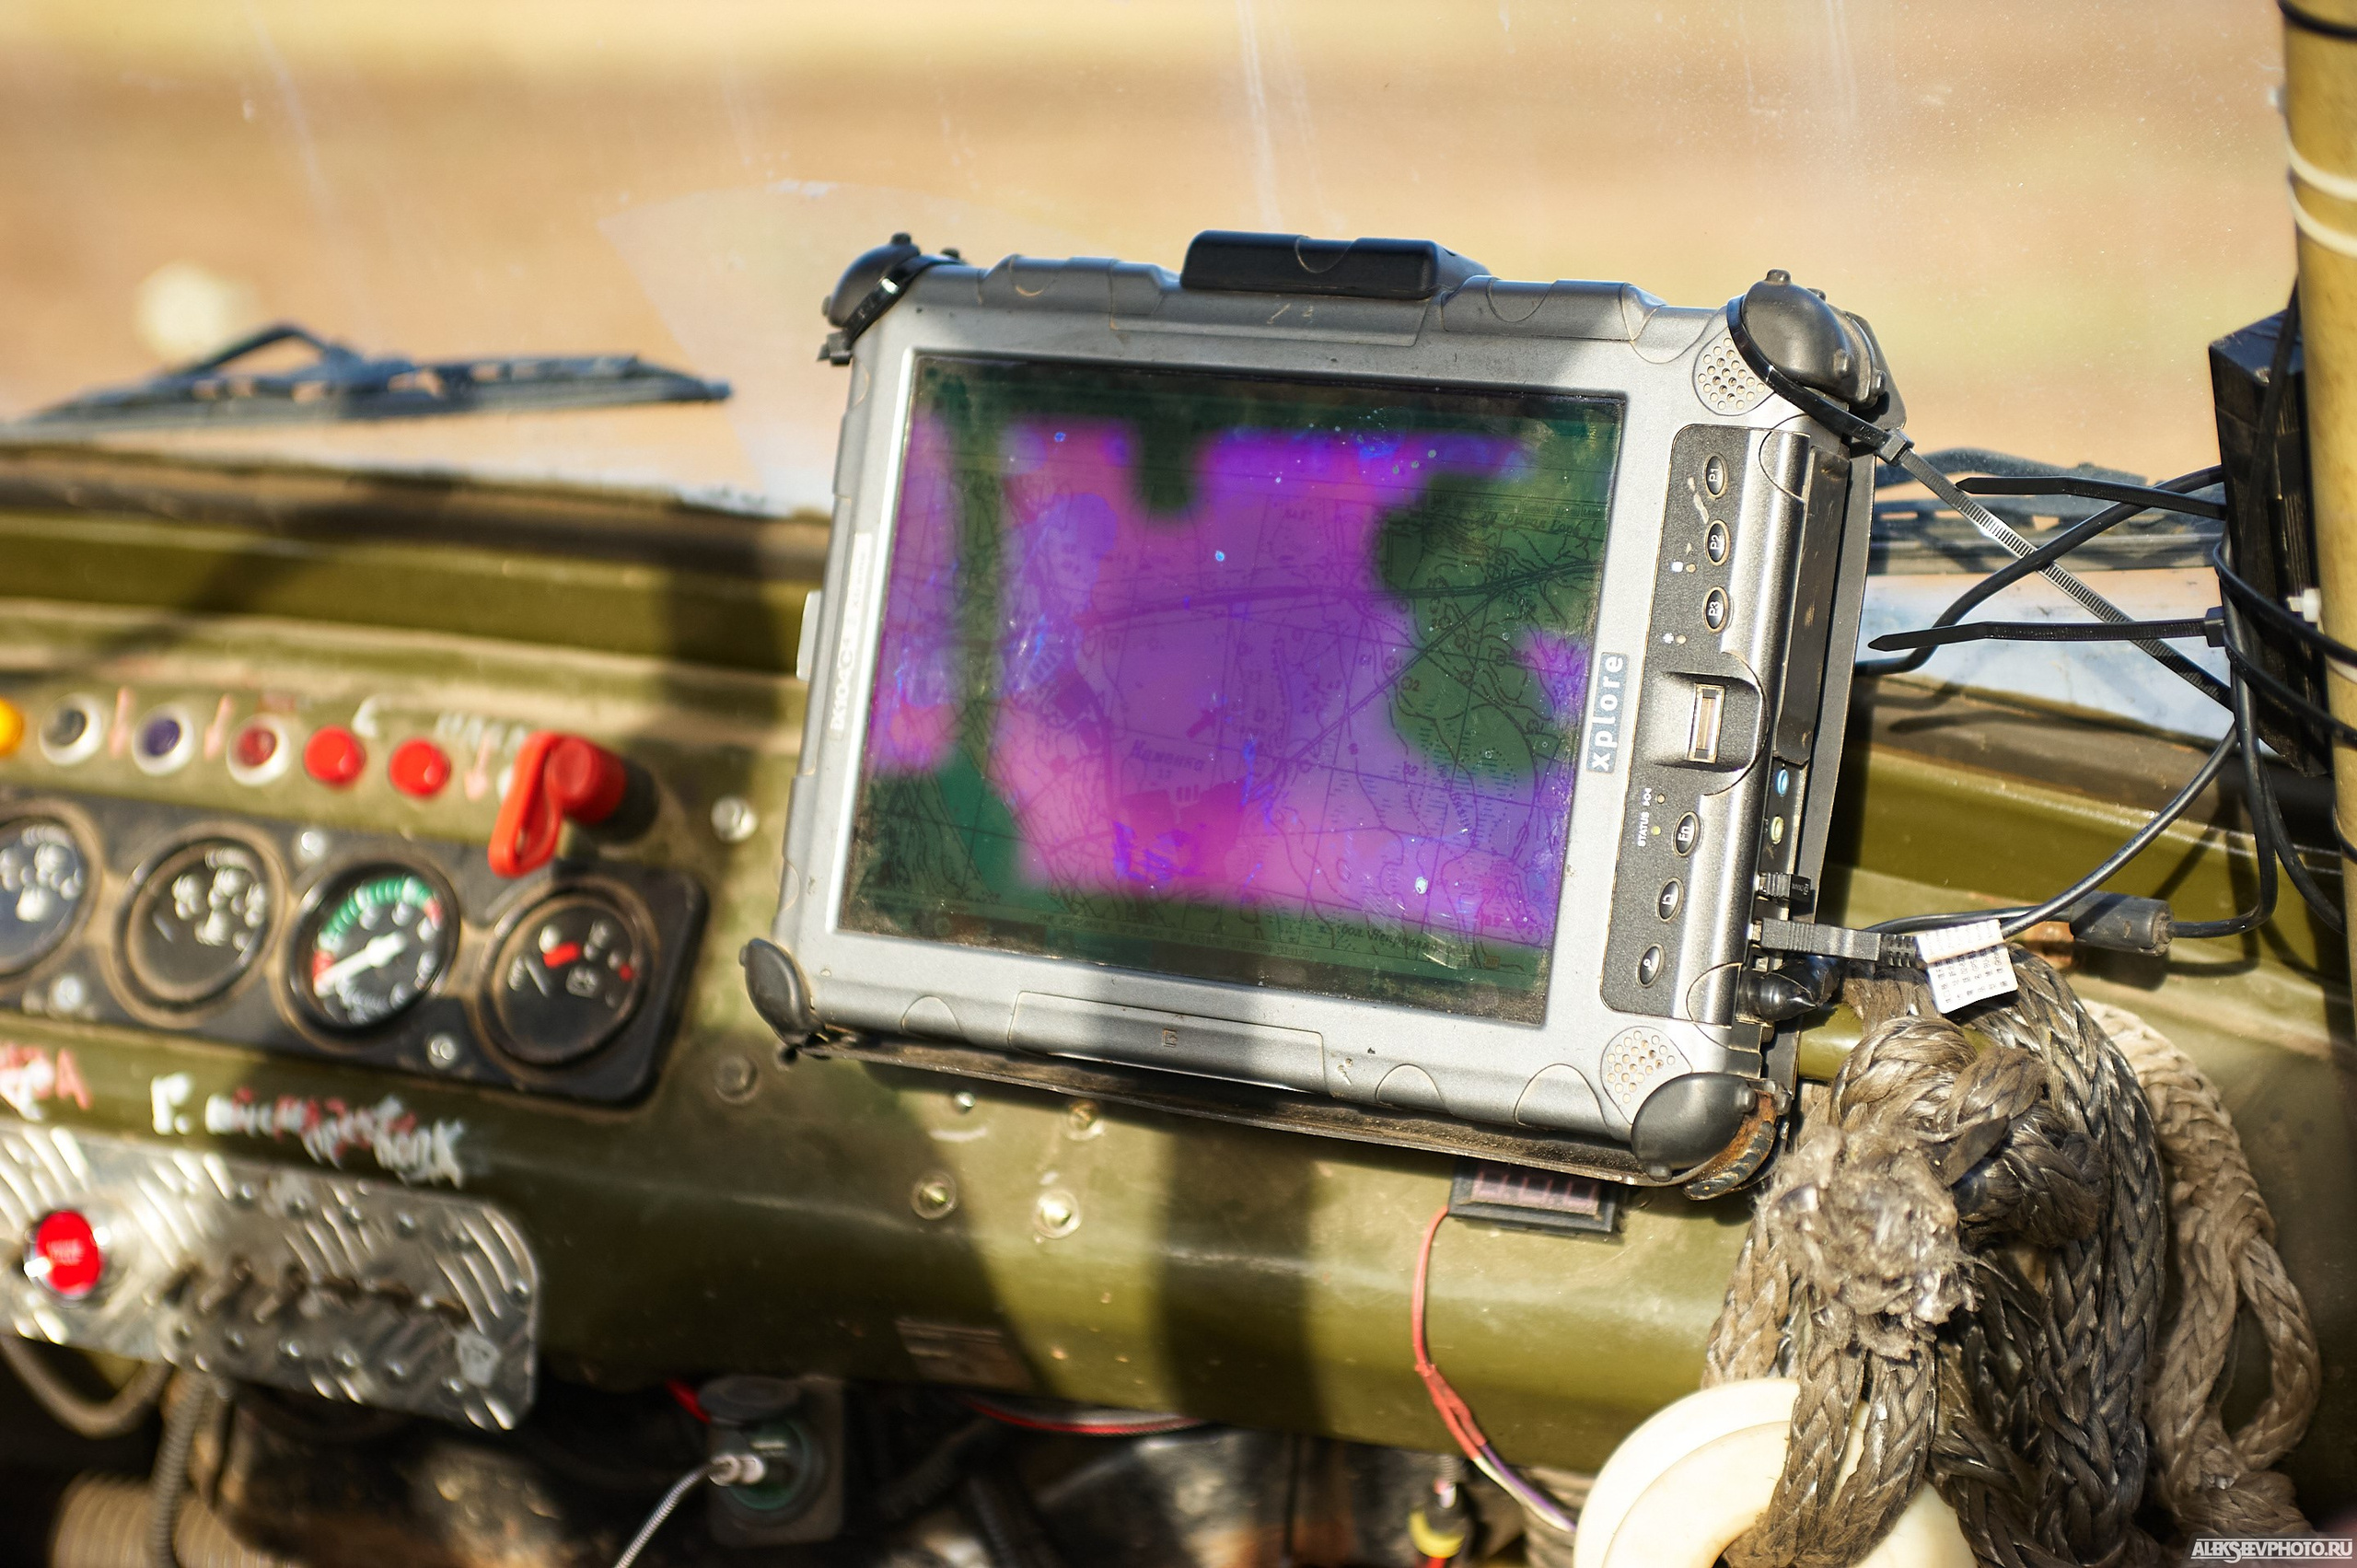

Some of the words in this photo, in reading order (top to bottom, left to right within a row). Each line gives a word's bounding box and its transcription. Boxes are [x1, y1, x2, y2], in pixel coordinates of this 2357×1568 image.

[1708, 468, 1720, 482] P1
[1710, 534, 1723, 550] P2
[1708, 601, 1721, 617] P3
[1591, 656, 1624, 772] xplore
[1637, 812, 1650, 847] STATUS
[1678, 825, 1691, 842] Fn
